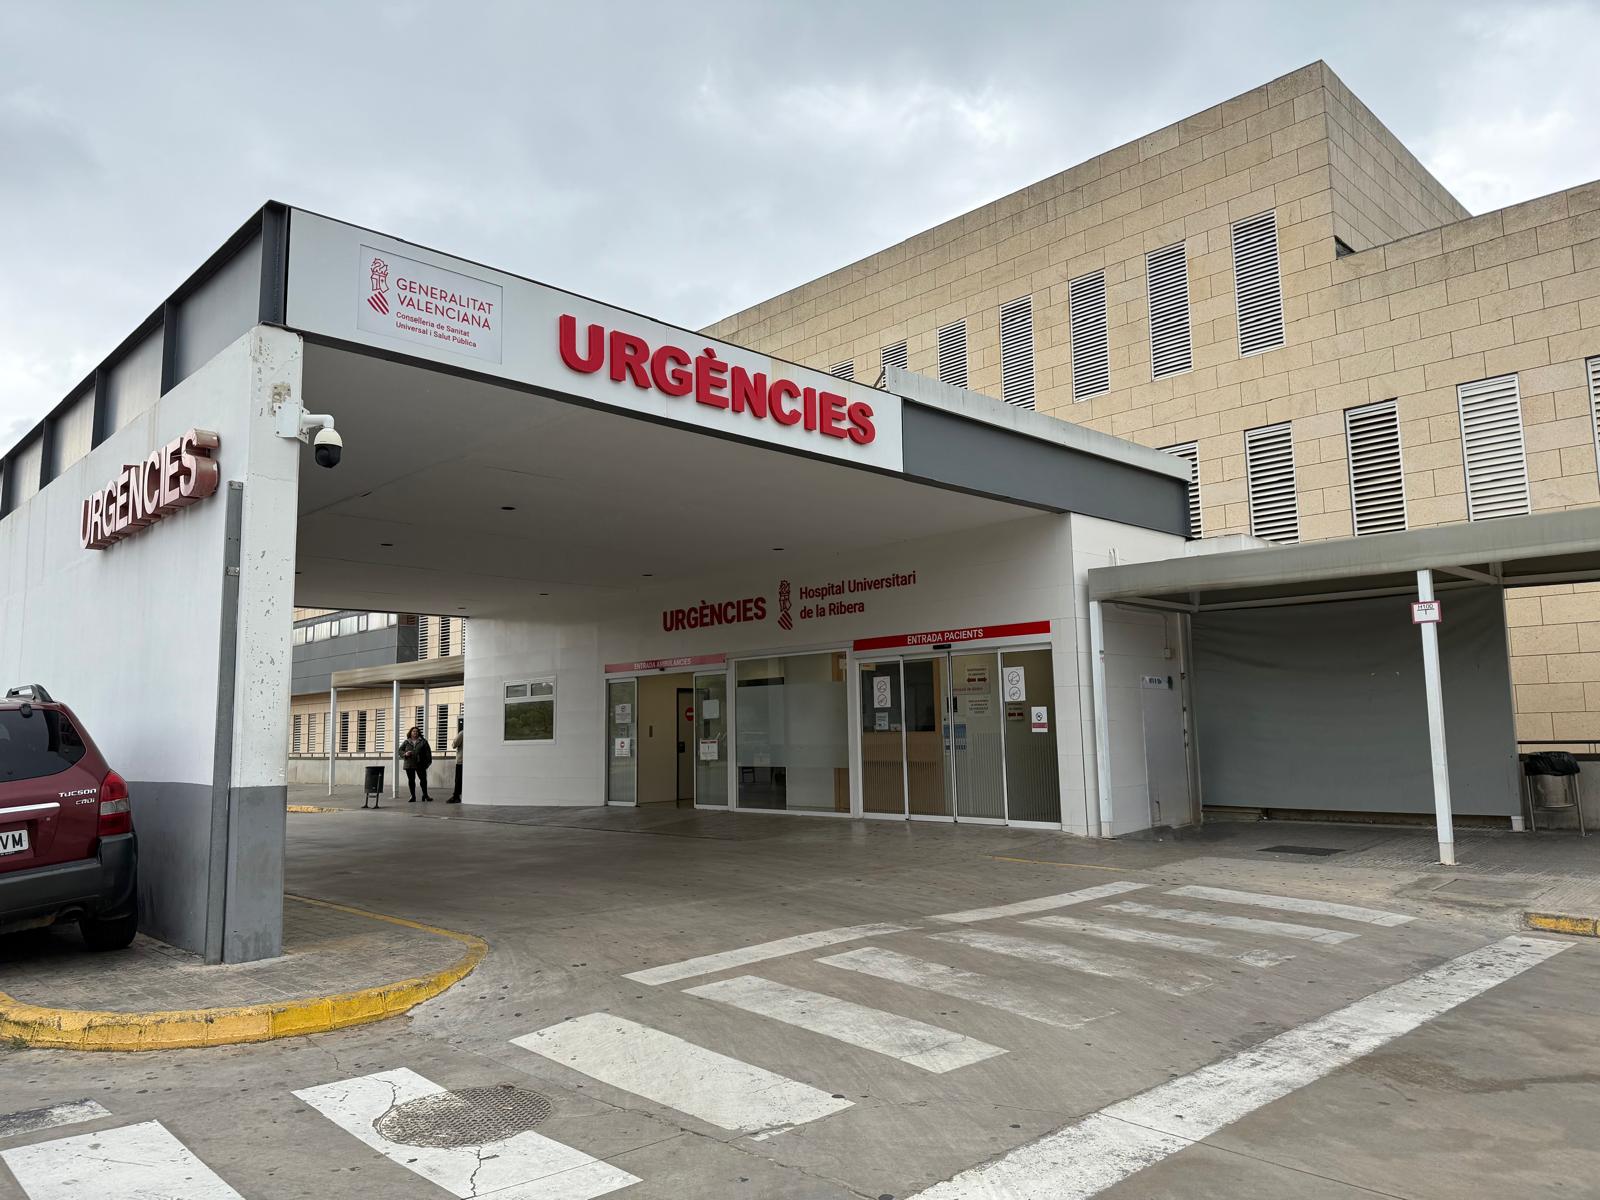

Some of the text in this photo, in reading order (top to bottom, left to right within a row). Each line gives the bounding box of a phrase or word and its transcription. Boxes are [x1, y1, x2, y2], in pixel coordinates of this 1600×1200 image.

[396, 277, 494, 315] GENERALITAT
[396, 311, 470, 338] Conselleria de Sanitat
[397, 293, 491, 330] VALENCIANA
[396, 321, 428, 336] Universal
[433, 330, 451, 342] Salut
[452, 334, 477, 348] Pública
[559, 313, 876, 445] URGÈNCIES
[80, 428, 219, 550] URGÈNCIES
[800, 570, 916, 600] Hospital Universitari
[662, 597, 767, 632] URGÈNCIES
[800, 600, 865, 620] de la Ribera
[907, 628, 984, 645] ENTRADA PACIENTS
[633, 657, 692, 671] ENTRADA AMBULANCES
[58, 789, 97, 798] TUCSON
